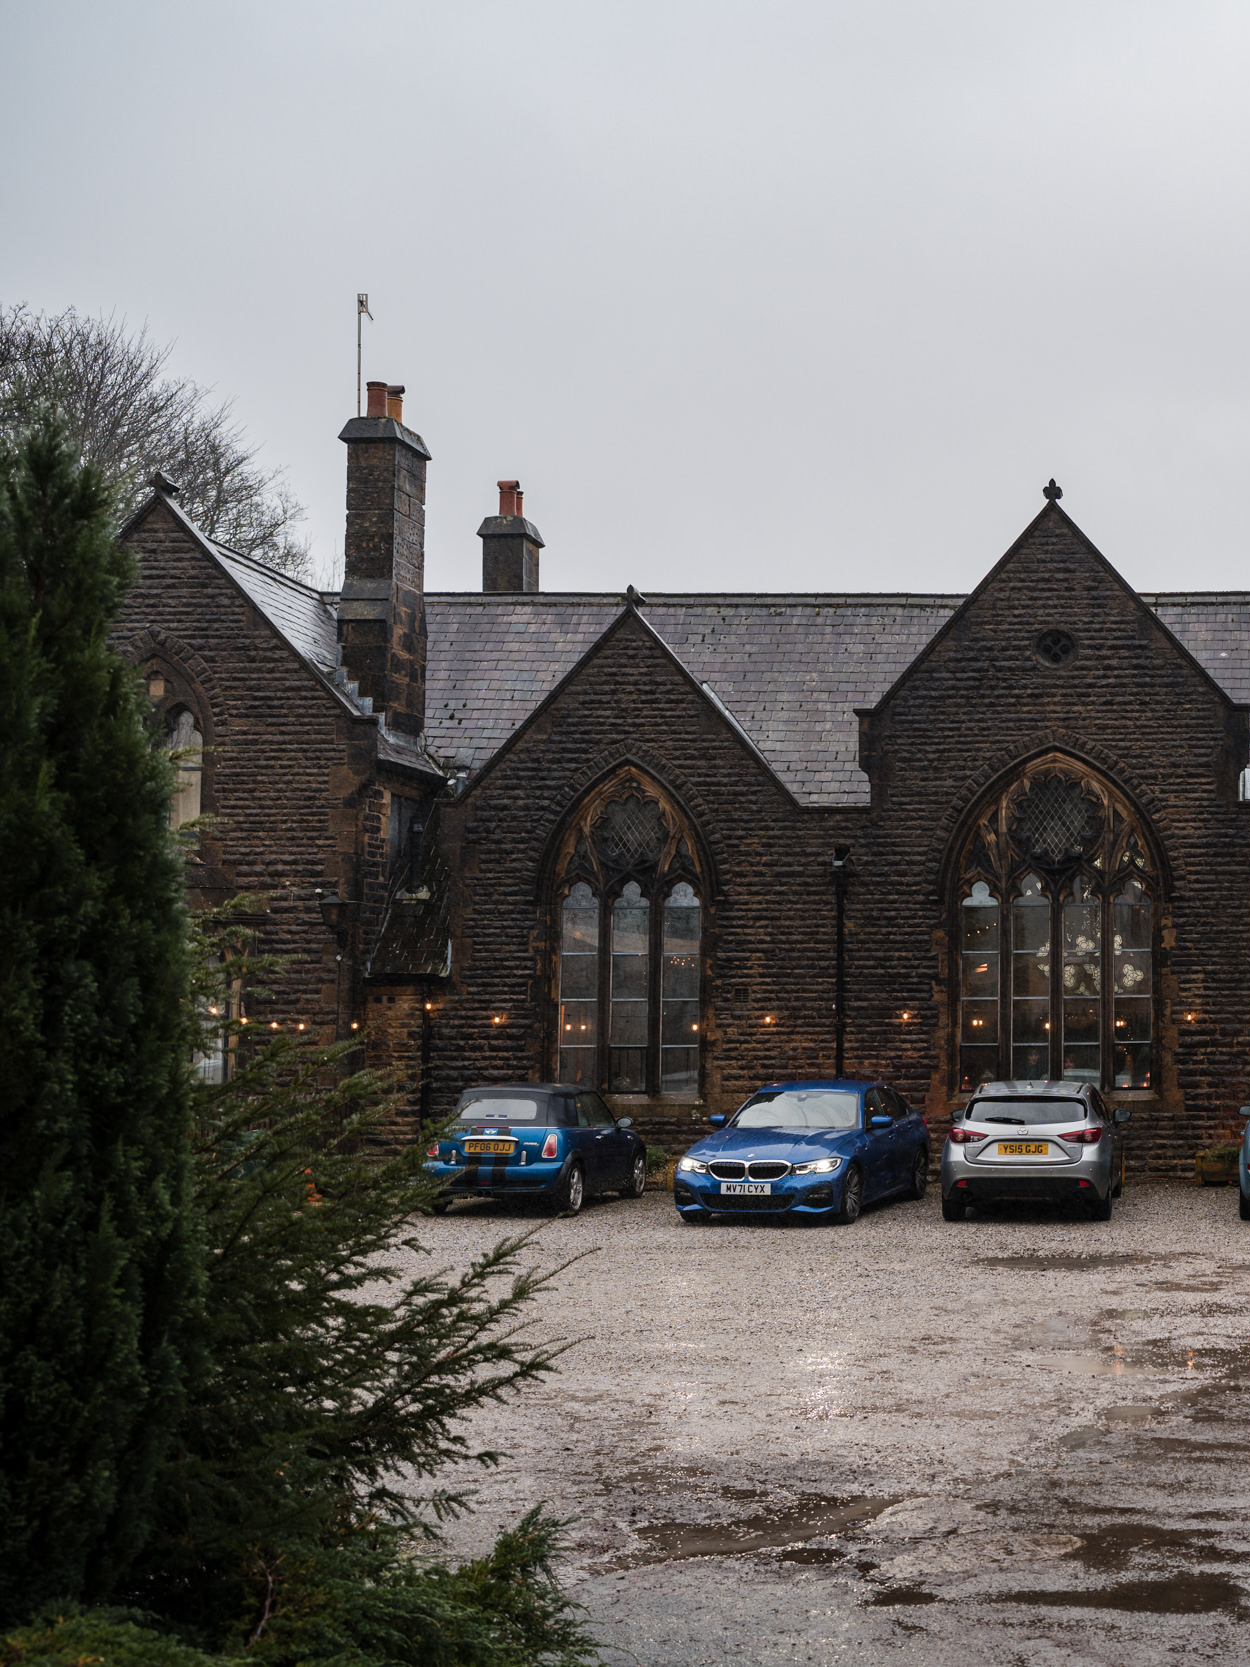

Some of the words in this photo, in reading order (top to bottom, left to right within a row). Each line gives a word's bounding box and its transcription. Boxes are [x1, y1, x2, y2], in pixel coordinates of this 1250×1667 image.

[468, 1142, 492, 1152] PF06
[493, 1143, 512, 1153] OJJ
[1003, 1144, 1023, 1154] YS15
[1025, 1144, 1043, 1154] GJG
[726, 1184, 746, 1193] MV71
[747, 1184, 766, 1194] CYX
